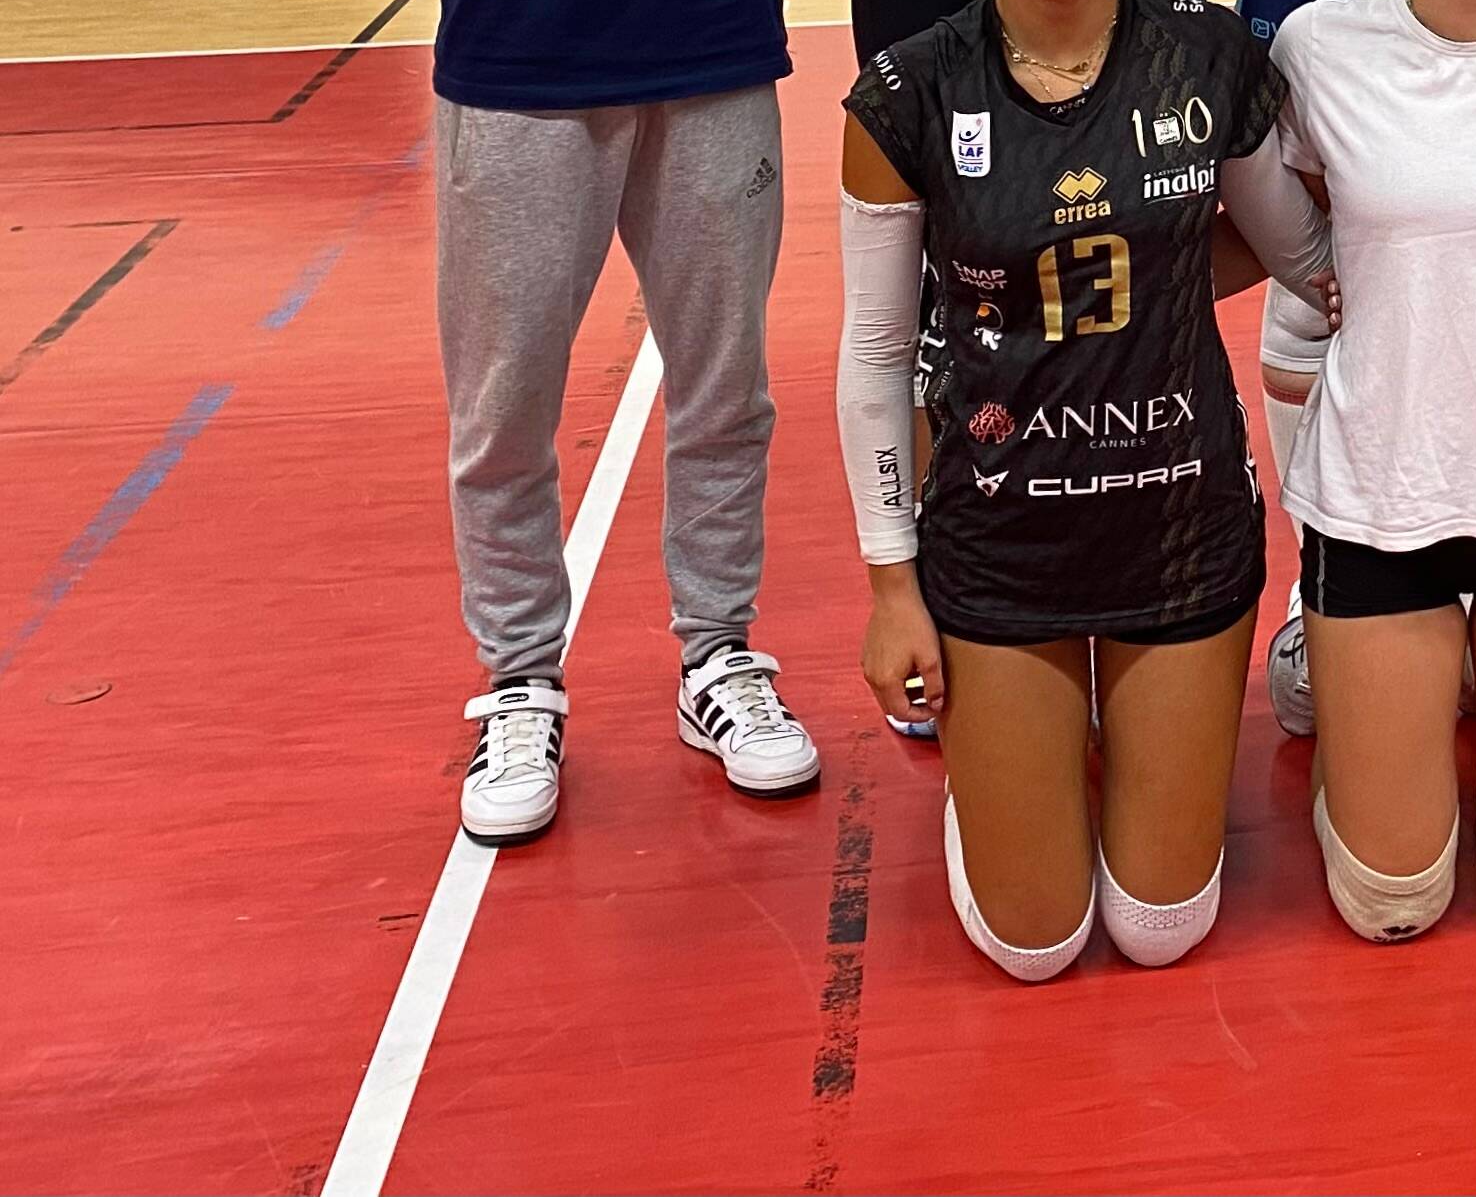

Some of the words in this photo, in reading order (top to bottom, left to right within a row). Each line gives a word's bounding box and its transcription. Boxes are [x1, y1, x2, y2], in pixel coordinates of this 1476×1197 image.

[959, 145, 984, 157] LAF
[1143, 159, 1216, 199] inalpi
[1037, 233, 1131, 342] 13
[1022, 388, 1194, 439] ANNEX
[1089, 437, 1146, 450] CANNES
[875, 446, 902, 506] ALLSIX
[1028, 459, 1201, 496] CUPRA
